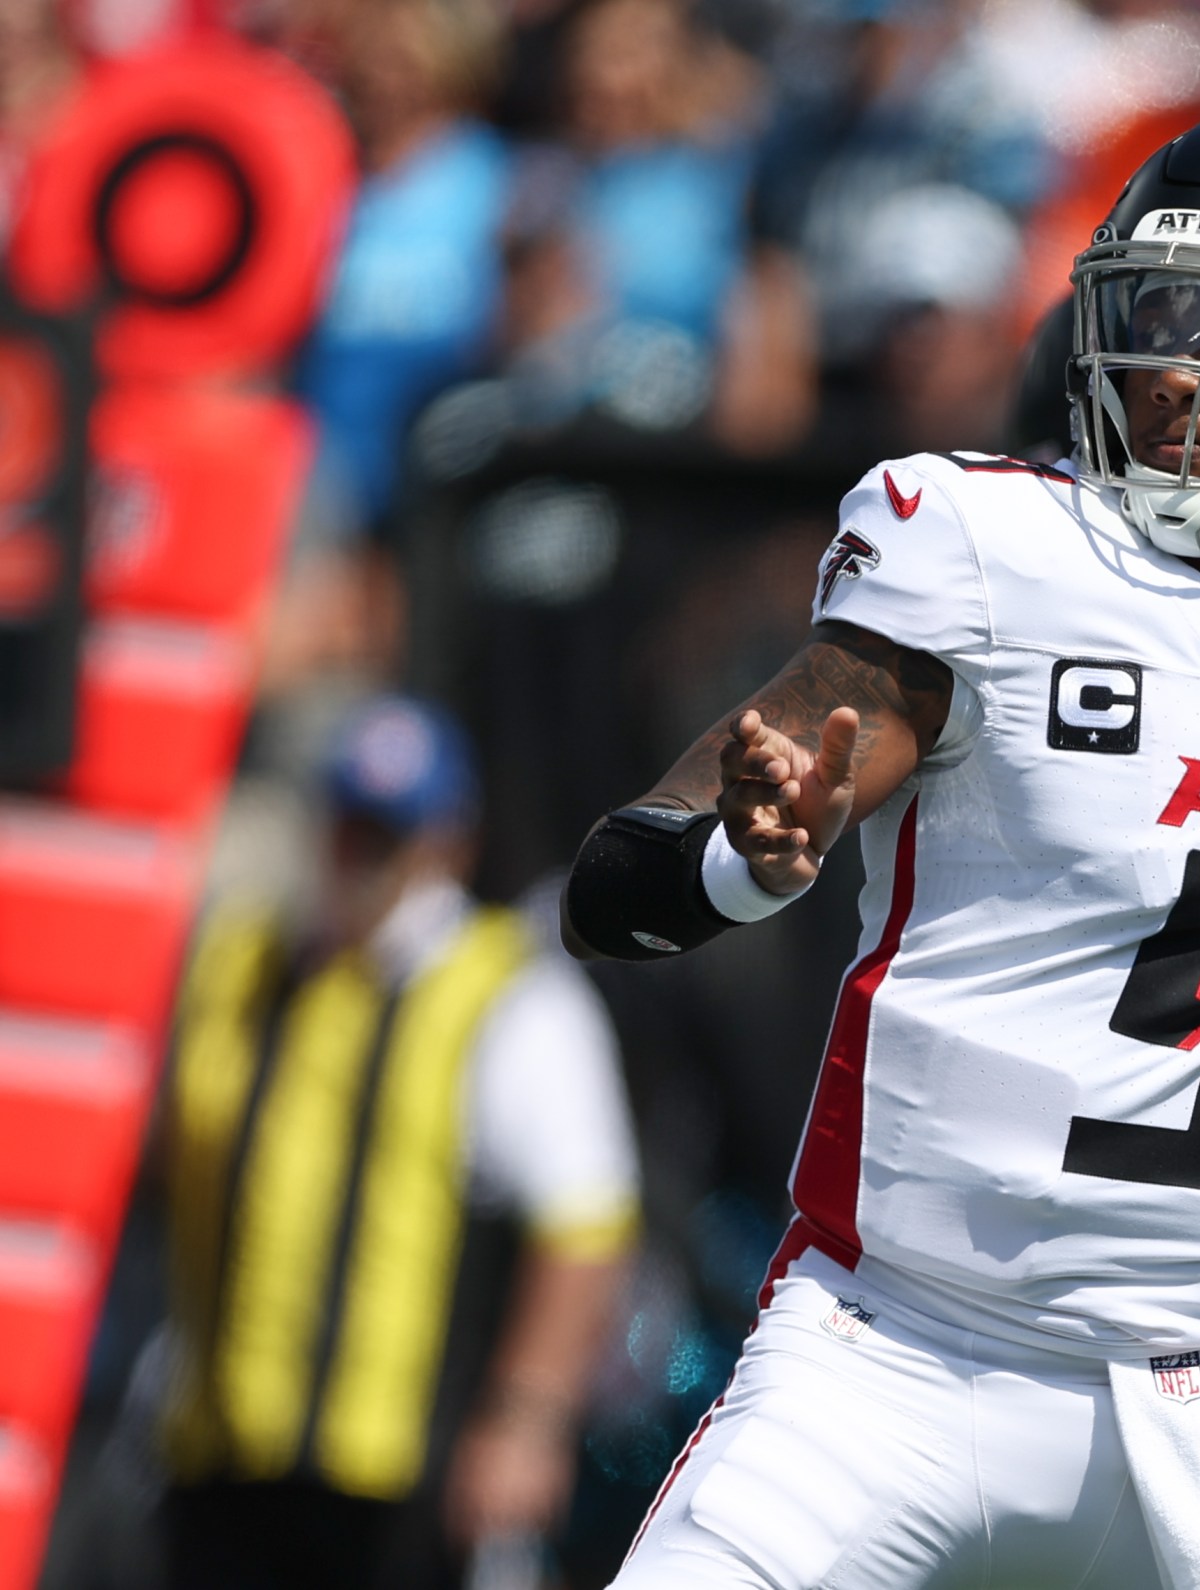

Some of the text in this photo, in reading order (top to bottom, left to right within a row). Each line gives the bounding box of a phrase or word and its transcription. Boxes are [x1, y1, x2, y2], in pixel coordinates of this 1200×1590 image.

[1057, 666, 1136, 729] C
[828, 1311, 857, 1335] NFL
[1158, 1369, 1200, 1397] NFL
